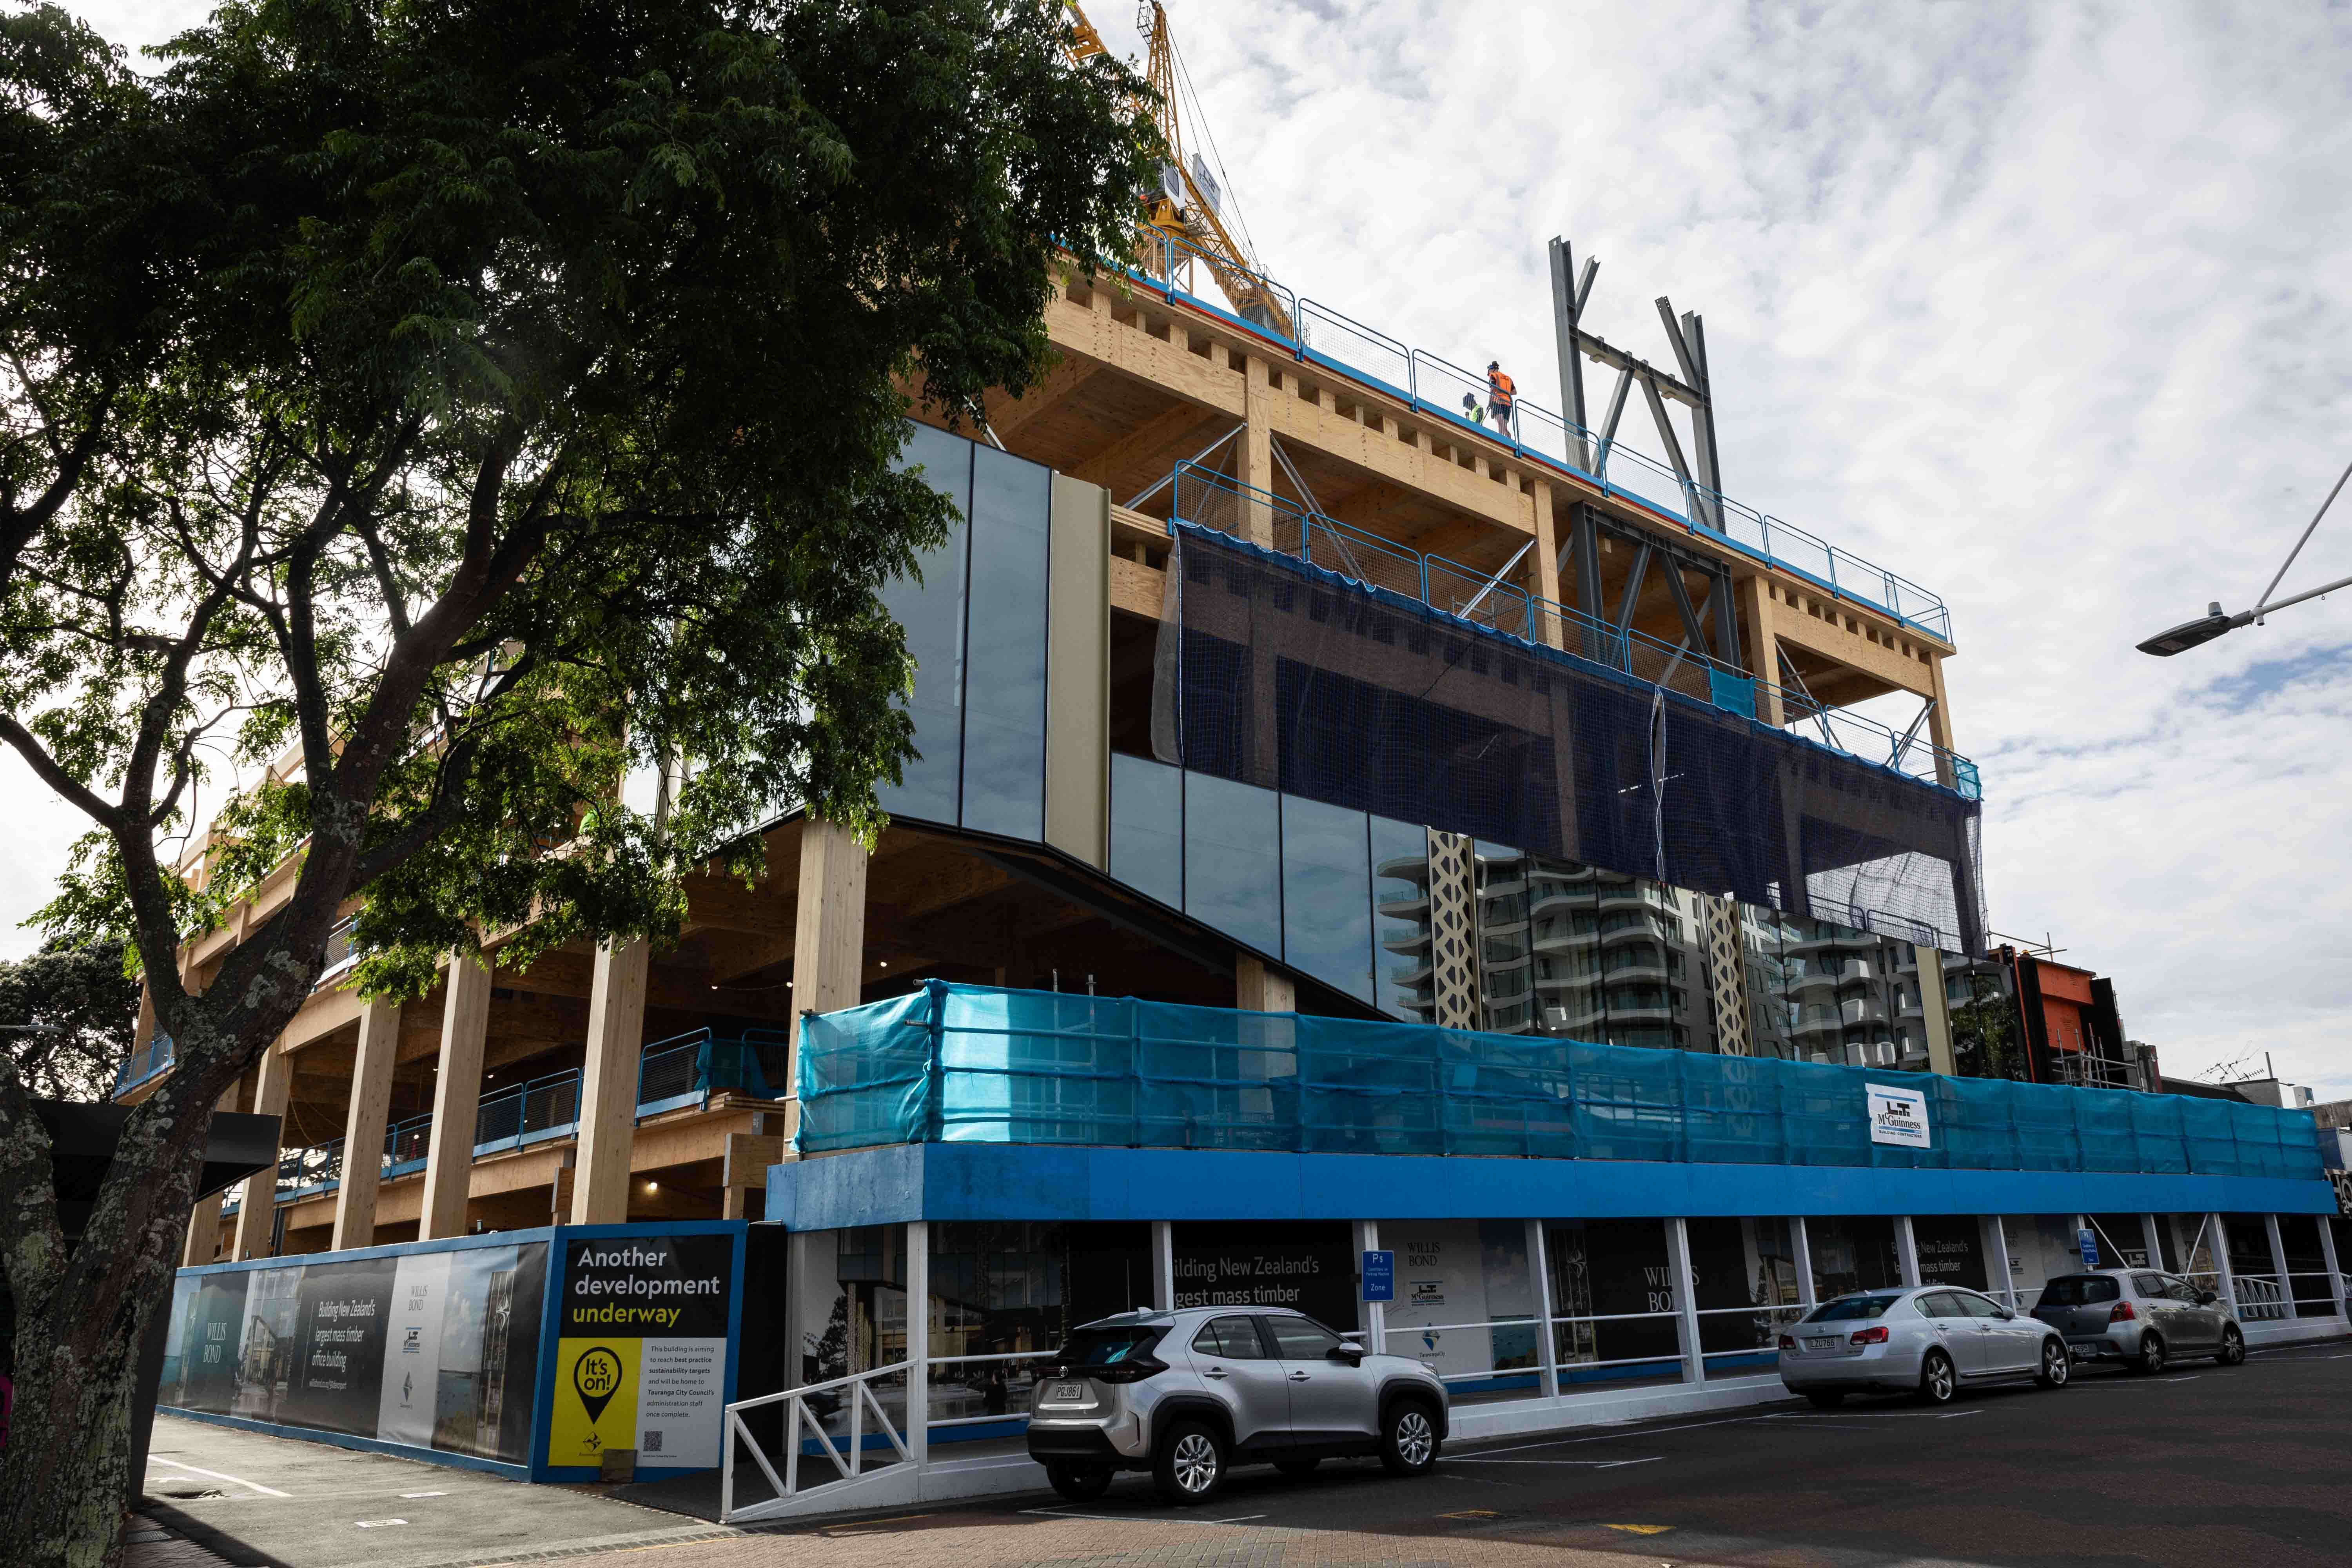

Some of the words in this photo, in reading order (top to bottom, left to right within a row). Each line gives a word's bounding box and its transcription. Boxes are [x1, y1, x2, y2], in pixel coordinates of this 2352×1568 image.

[1878, 1112, 1920, 1129] McGuinness
[1408, 1242, 1440, 1253] WILLIS
[1921, 1241, 1935, 1254] New
[1936, 1240, 1968, 1253] Zealand's
[577, 1247, 667, 1267] Another
[1220, 1257, 1250, 1276] New
[1255, 1255, 1319, 1275] Zealand's
[1409, 1255, 1437, 1267] BOND
[1920, 1263, 1938, 1273] mass
[1938, 1258, 1961, 1272] timber
[575, 1274, 720, 1299] development
[1212, 1292, 1250, 1305] mass
[1254, 1284, 1300, 1304] timber
[1371, 1283, 1387, 1292] Zone
[319, 1301, 339, 1322] Building
[339, 1300, 350, 1317] New
[350, 1298, 376, 1317] Zealand's
[573, 1302, 681, 1328] underway
[207, 1323, 227, 1341] WILLIS
[315, 1325, 332, 1347] largest
[332, 1330, 346, 1342] mass
[346, 1324, 364, 1342] timber
[203, 1345, 221, 1363] BOND
[312, 1350, 326, 1366] office
[326, 1349, 347, 1372] building
[586, 1358, 607, 1375] It's
[584, 1374, 611, 1390] on!
